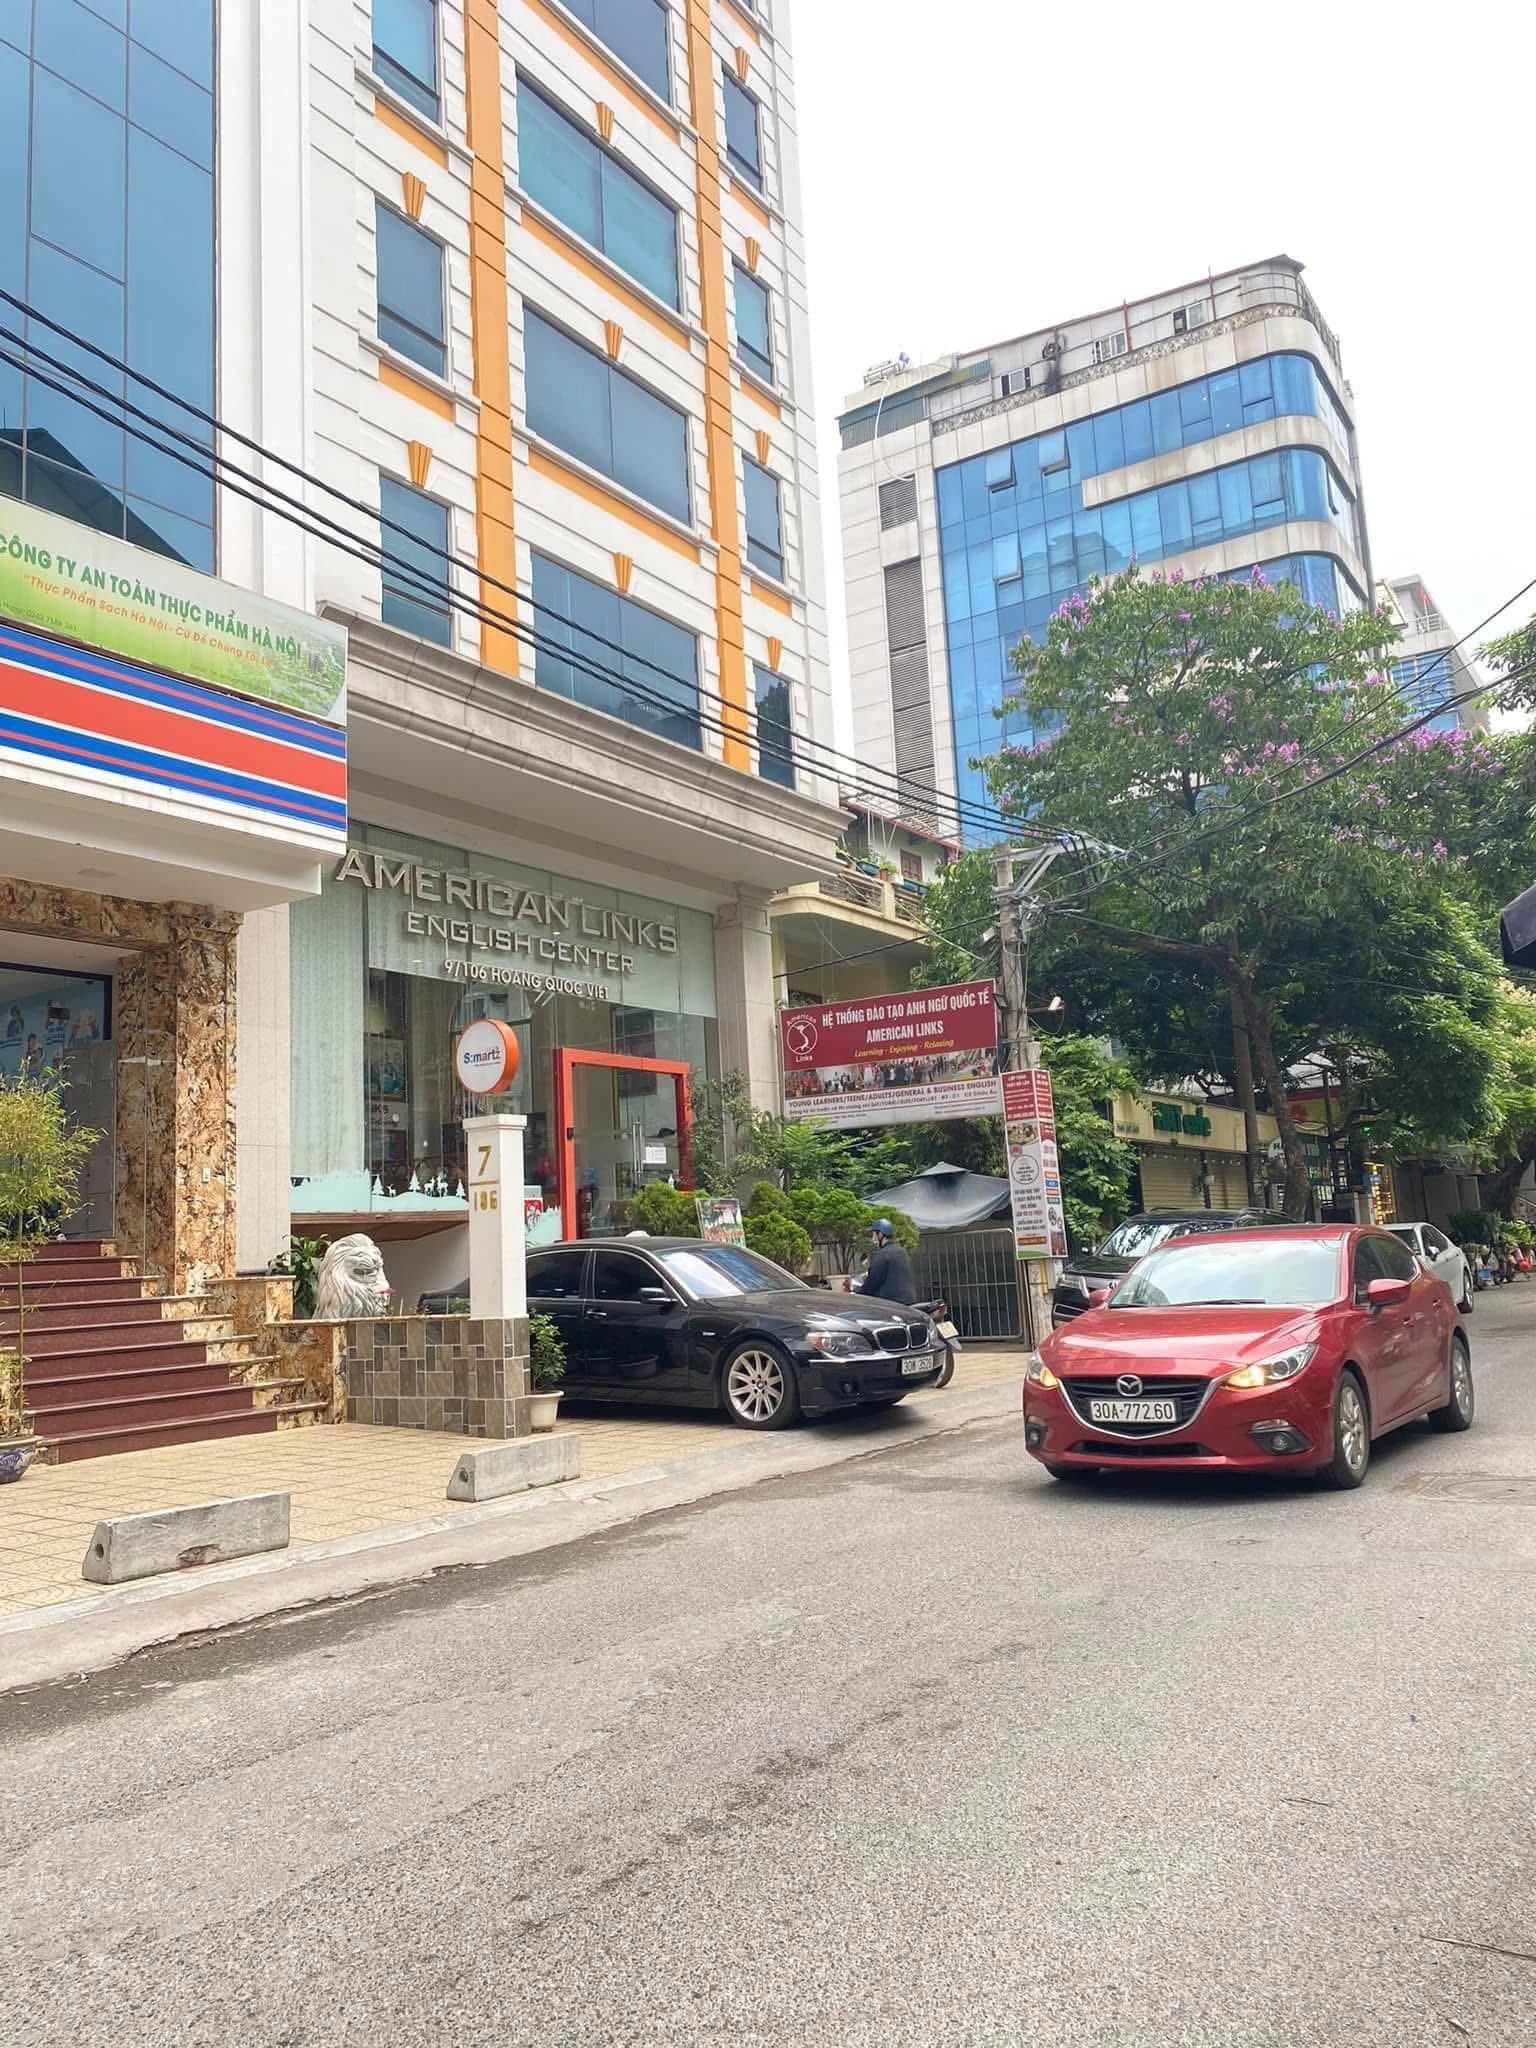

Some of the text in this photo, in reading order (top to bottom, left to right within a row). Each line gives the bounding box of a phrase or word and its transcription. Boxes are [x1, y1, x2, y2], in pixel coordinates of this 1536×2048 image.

[57, 555, 77, 578] TY
[81, 565, 105, 589] AN
[110, 574, 155, 607] TOÀN
[160, 593, 202, 623] THỰC
[205, 609, 249, 640] PHẨM
[252, 626, 273, 649] HÀ
[276, 636, 301, 661] NỘI
[336, 847, 677, 954] AMERICAN LINKS
[407, 911, 635, 974] ENGLISH CENTER
[491, 967, 542, 988] HOANG
[545, 977, 583, 996] QUOC
[587, 982, 609, 1000] VIET
[866, 1004, 885, 1021] ĐÀO
[886, 1004, 904, 1021] TẠO
[906, 1000, 926, 1017] ANH
[866, 1020, 944, 1043] AMERICAN LINKS
[795, 1055, 813, 1063] Links
[478, 1144, 492, 1176] 7
